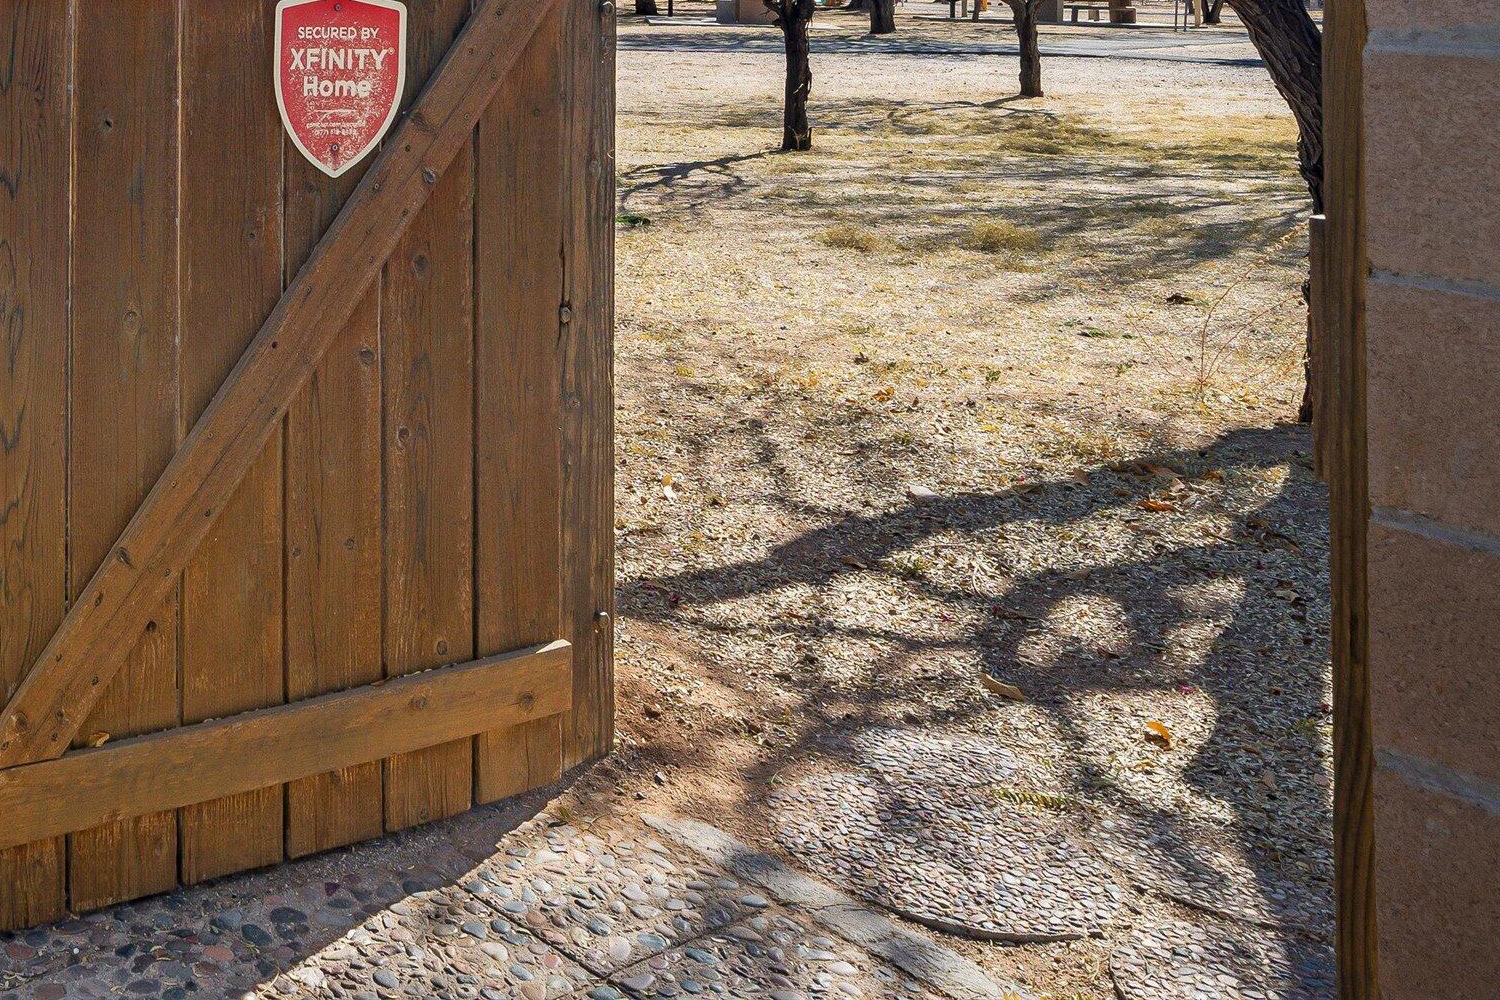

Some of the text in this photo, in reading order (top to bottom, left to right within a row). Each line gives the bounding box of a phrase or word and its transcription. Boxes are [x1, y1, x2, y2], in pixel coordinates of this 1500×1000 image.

[298, 26, 380, 39] SECURED BY
[303, 75, 372, 97] Home
